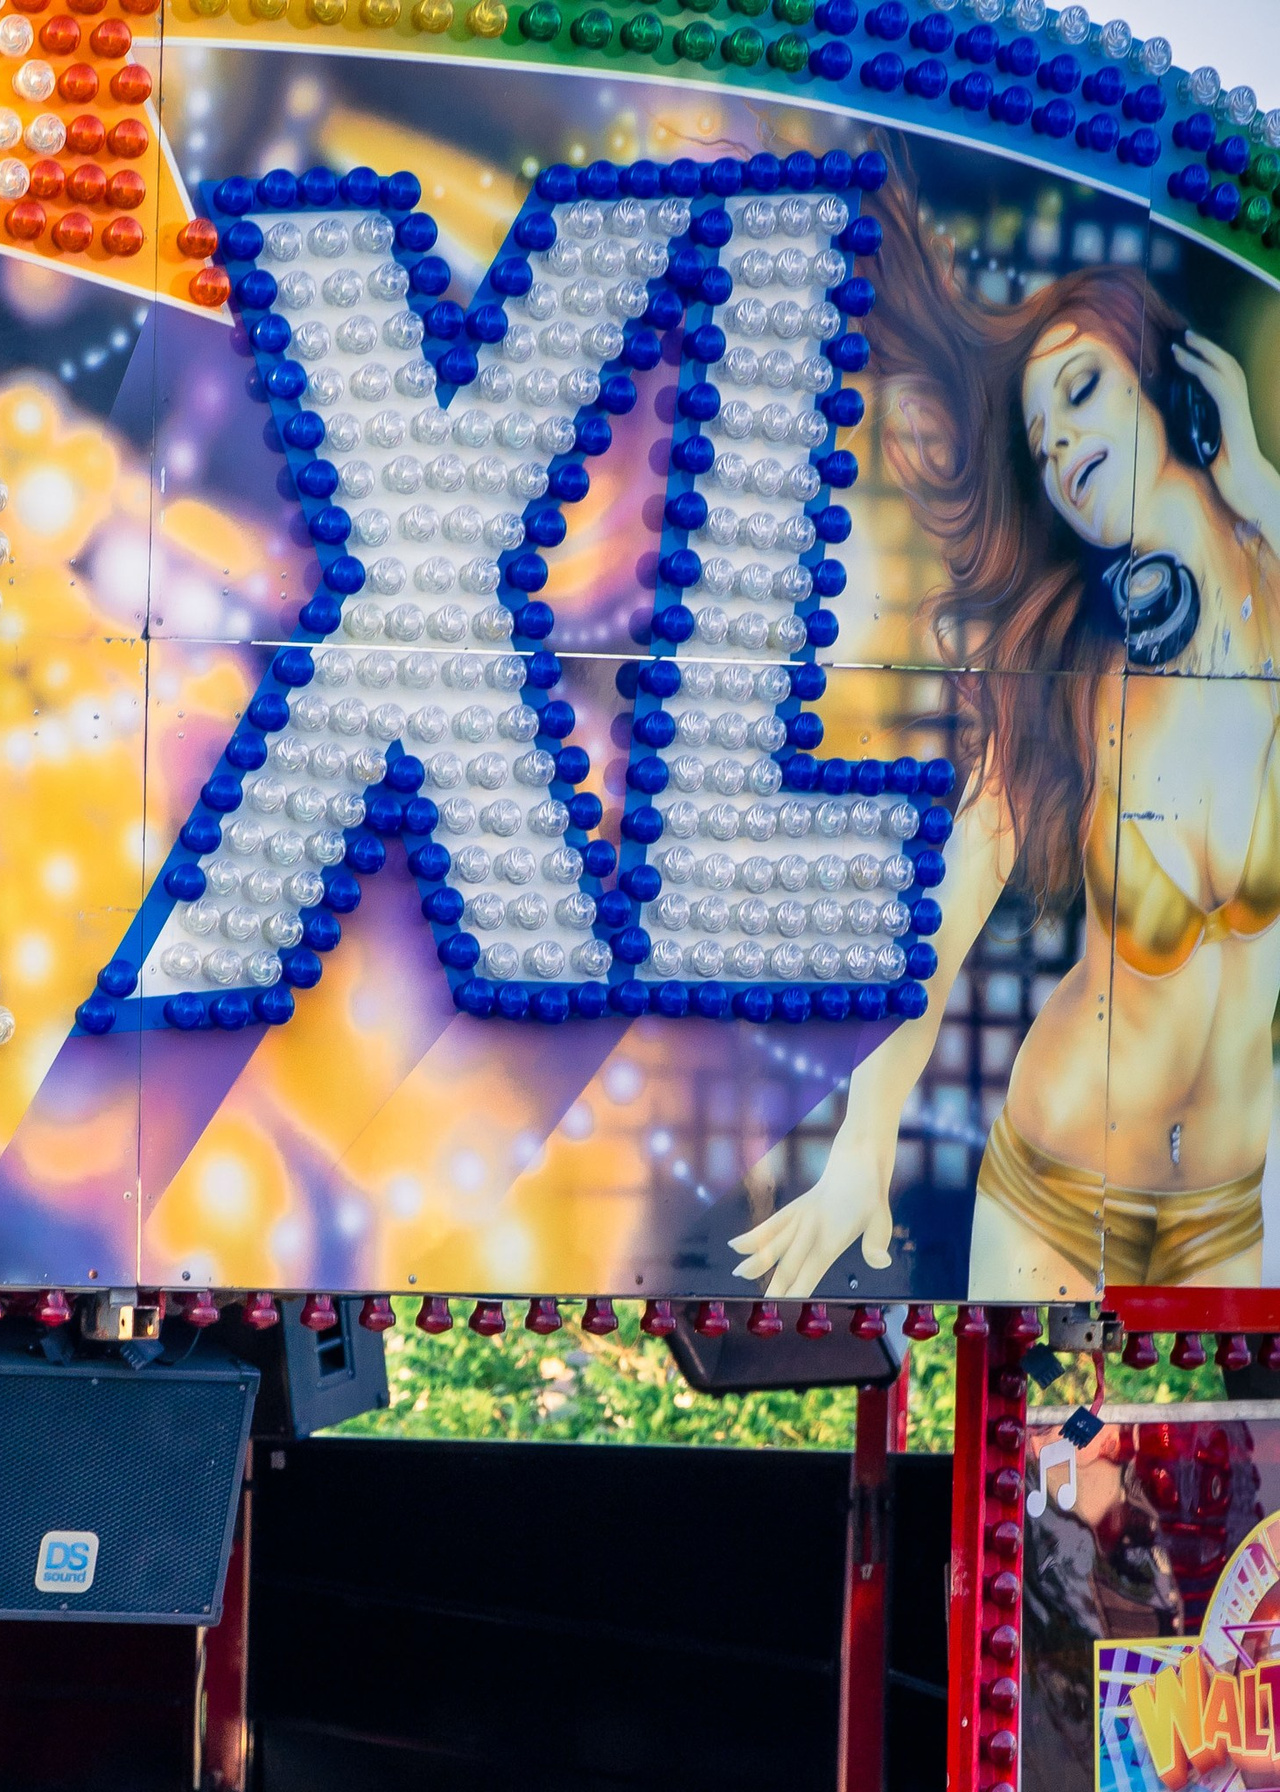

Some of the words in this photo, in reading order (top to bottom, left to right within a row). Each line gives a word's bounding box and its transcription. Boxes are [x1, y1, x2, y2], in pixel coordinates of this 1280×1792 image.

[72, 148, 956, 1036] XL
[44, 1541, 90, 1571] DS
[43, 1570, 87, 1584] sound
